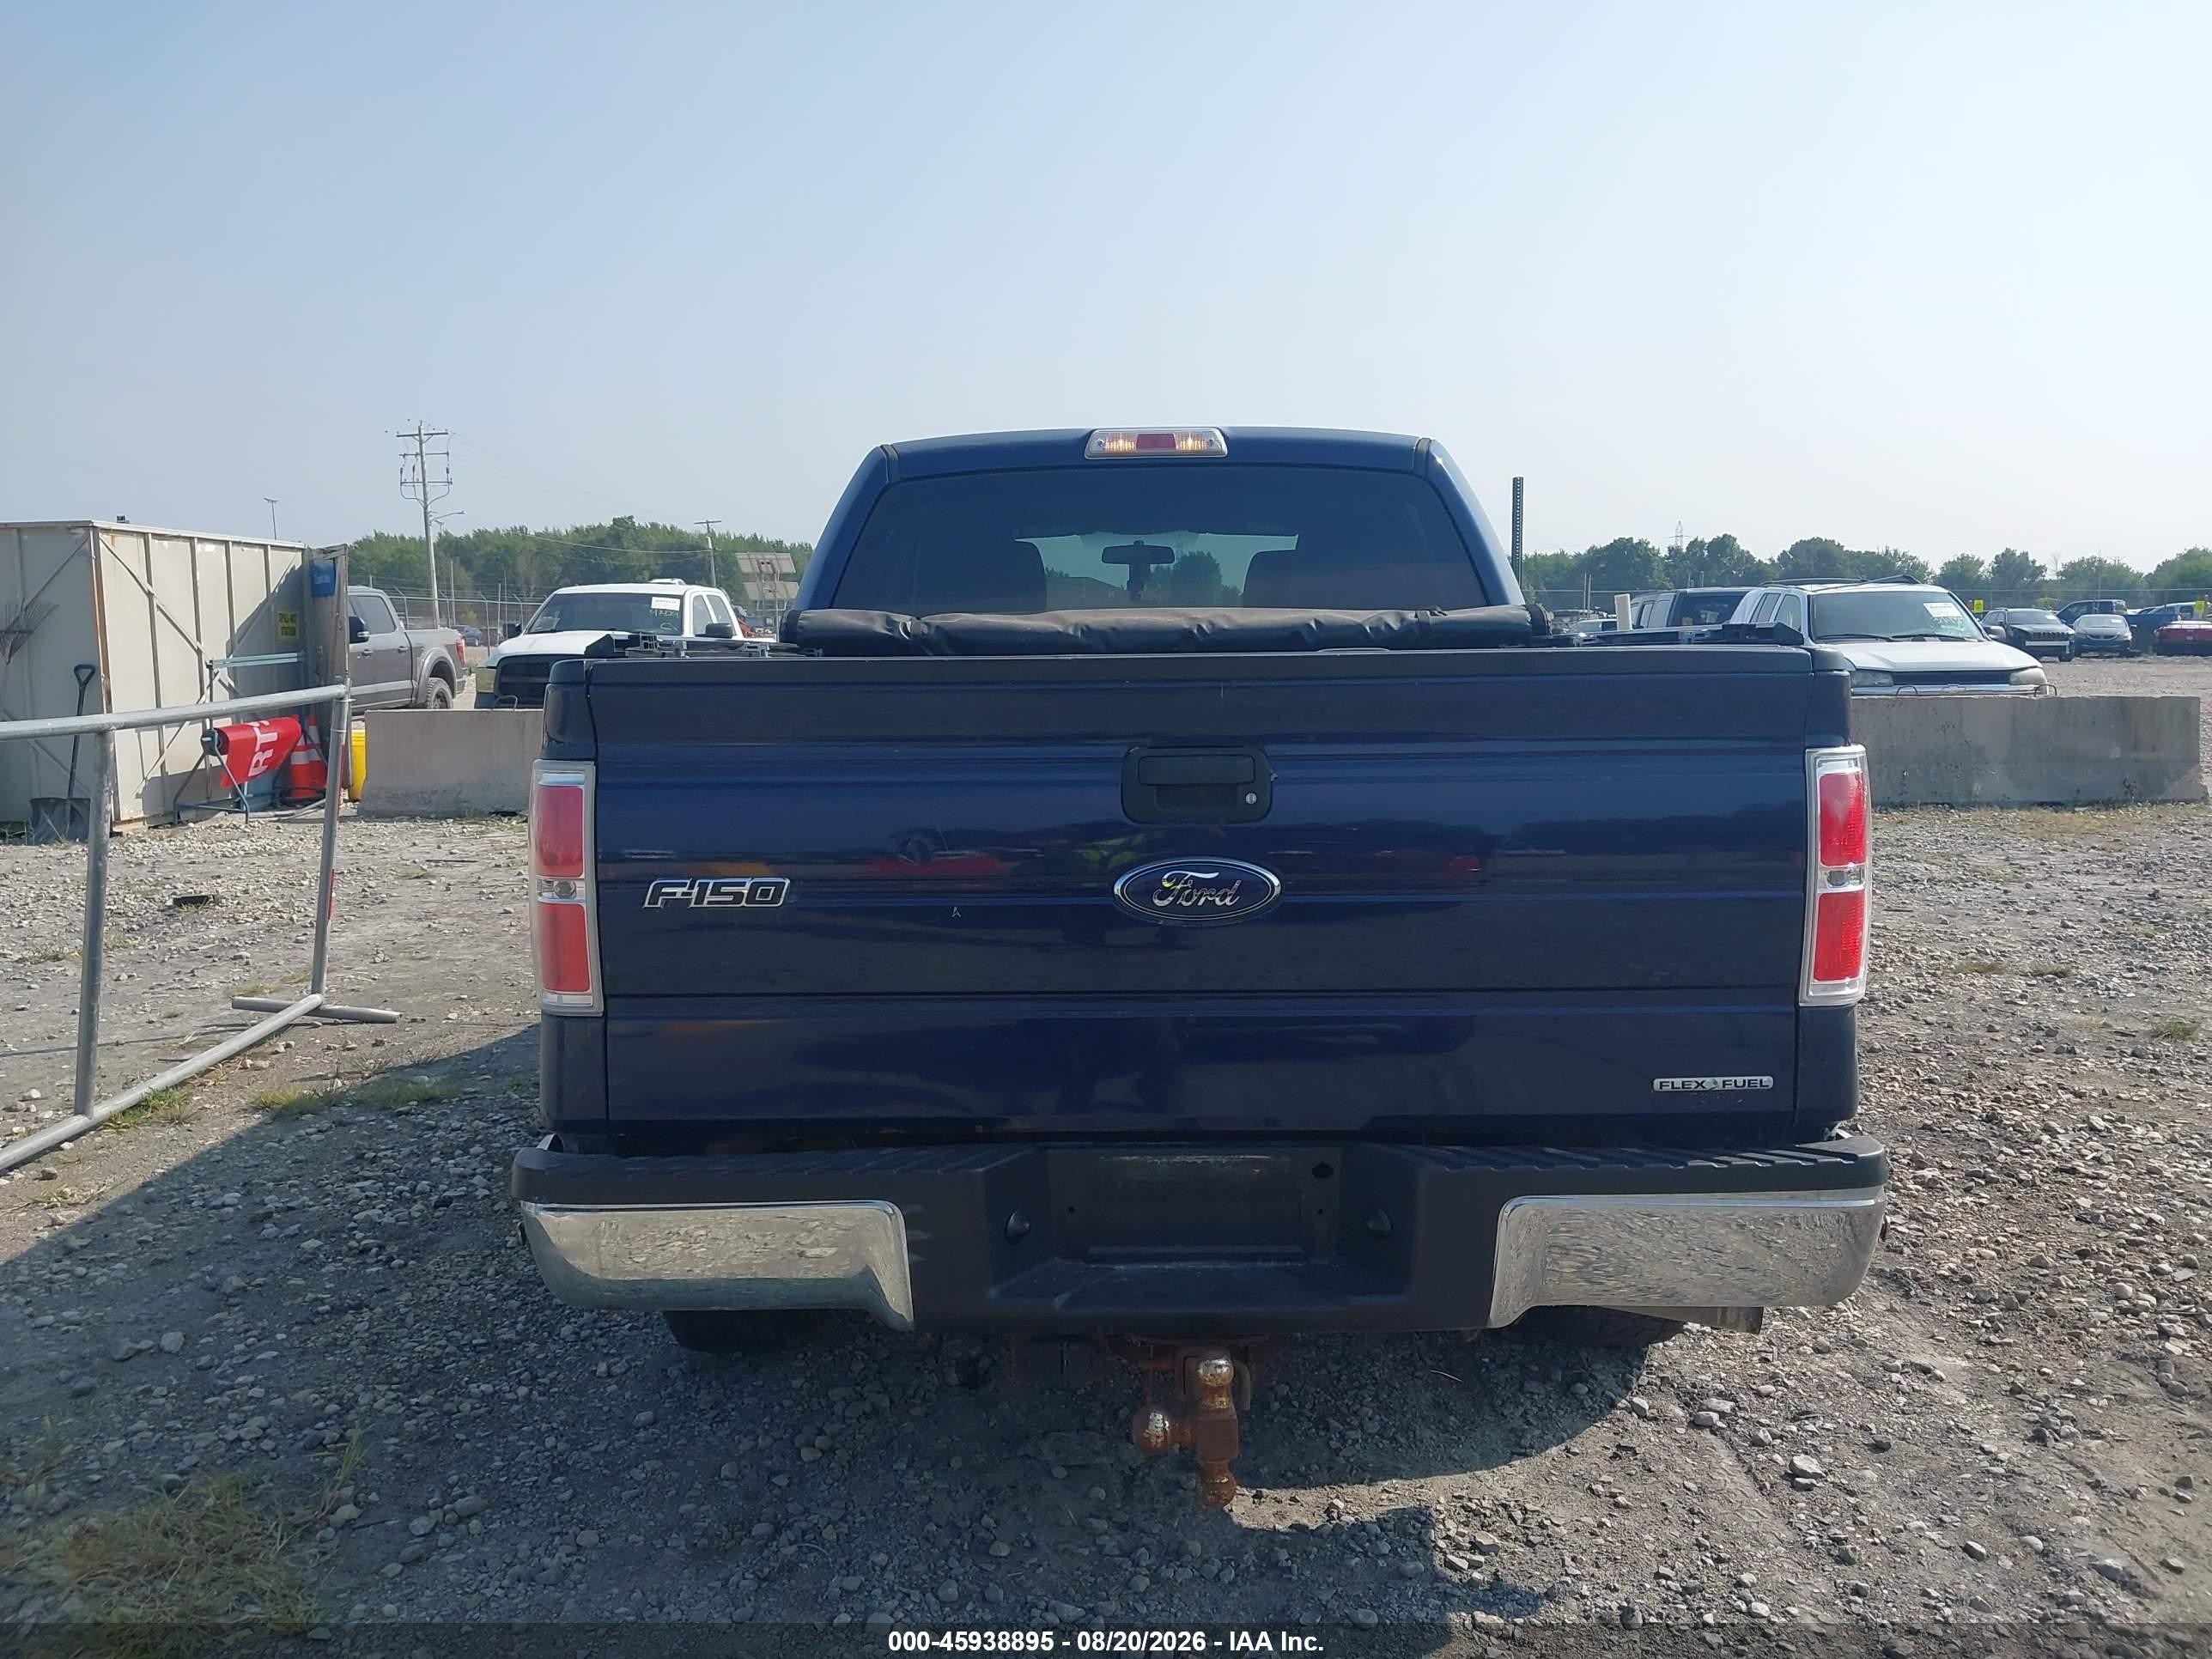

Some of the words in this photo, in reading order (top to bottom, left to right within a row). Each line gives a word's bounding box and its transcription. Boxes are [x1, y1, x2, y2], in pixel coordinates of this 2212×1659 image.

[642, 878, 790, 908] F-150
[1152, 870, 1242, 907] Ford
[1658, 1079, 1707, 1090] FLEX
[1722, 1079, 1770, 1089] FUEL
